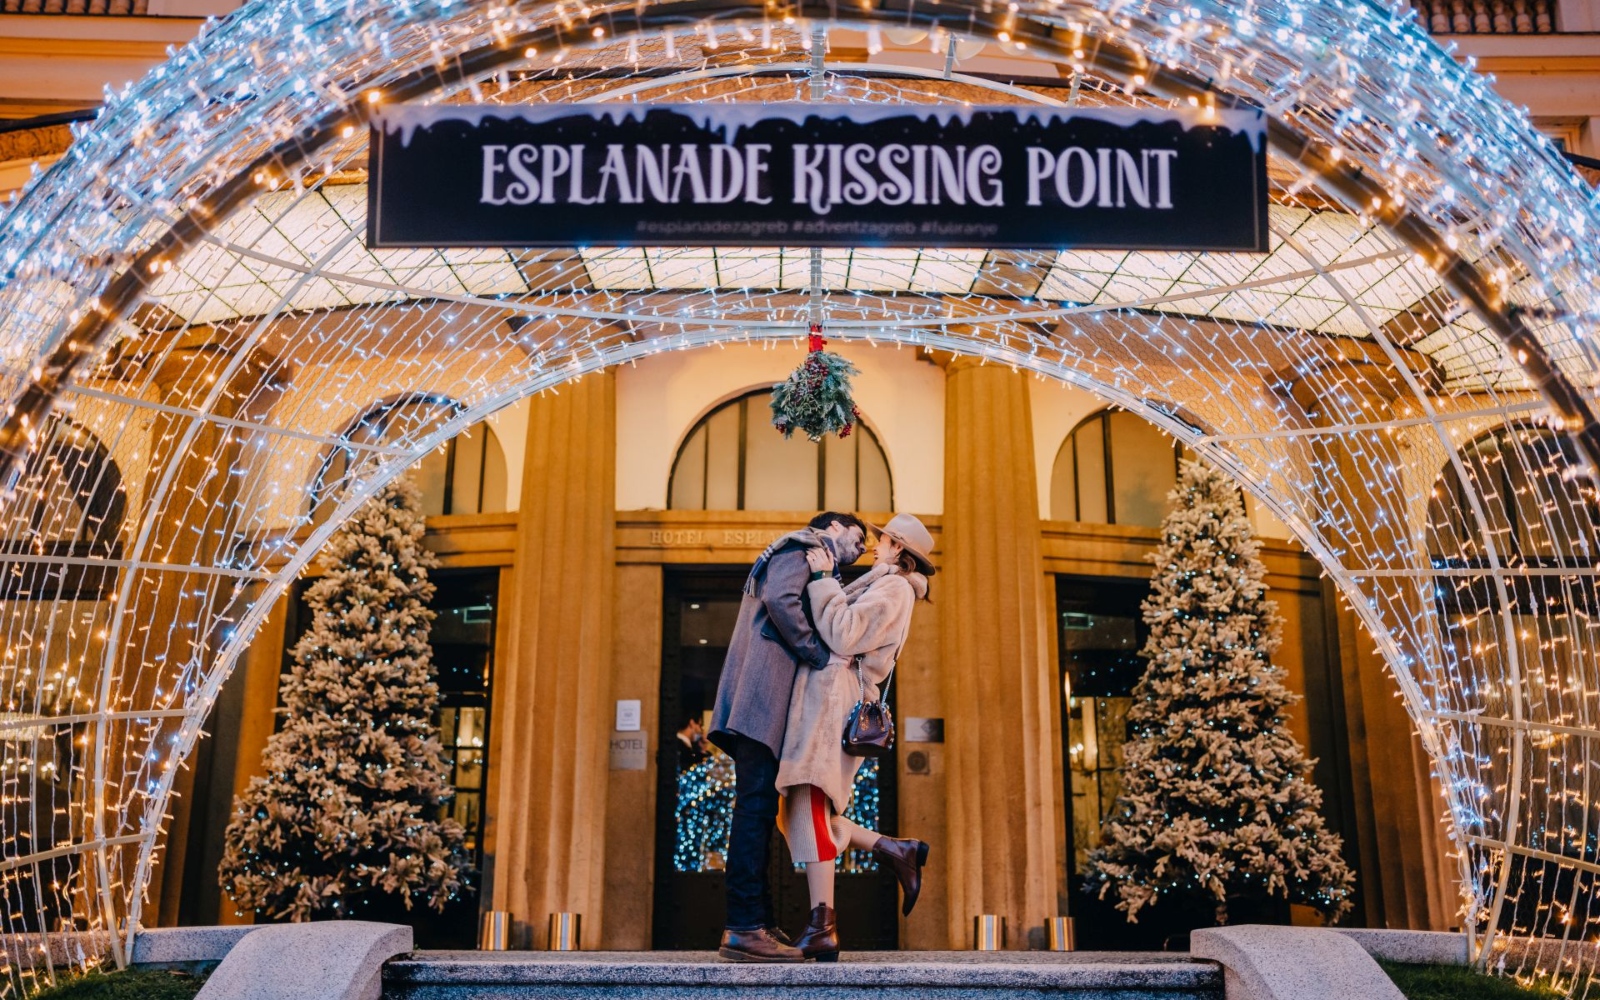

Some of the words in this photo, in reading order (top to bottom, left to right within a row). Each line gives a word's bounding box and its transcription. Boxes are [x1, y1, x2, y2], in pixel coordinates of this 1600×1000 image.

[481, 144, 772, 206] ESPLANADE
[792, 143, 1004, 215] KISSING
[1026, 146, 1178, 209] POINT
[636, 220, 788, 237] #esplanadezagreb
[792, 220, 917, 238] #adventzagreb
[651, 530, 707, 545] HOTEL
[610, 738, 645, 751] HOTEL
